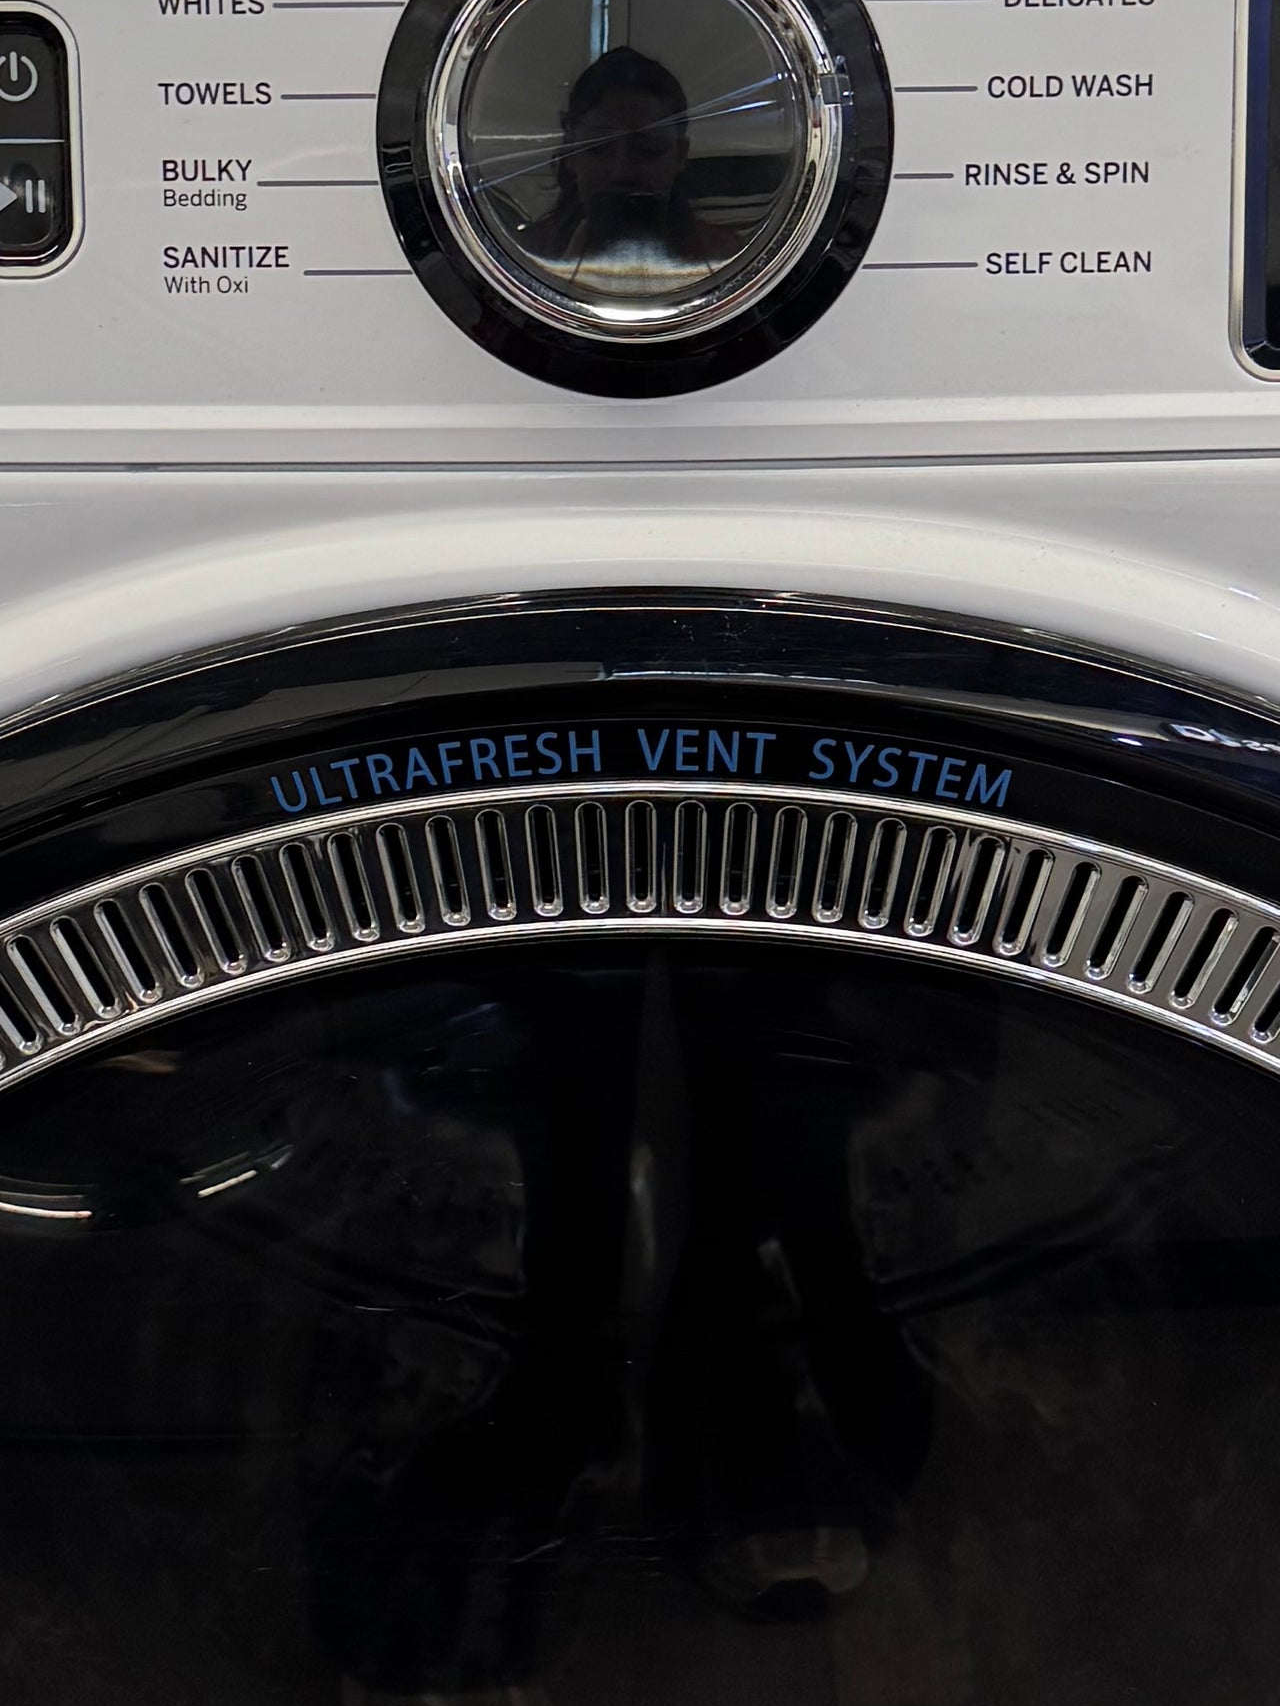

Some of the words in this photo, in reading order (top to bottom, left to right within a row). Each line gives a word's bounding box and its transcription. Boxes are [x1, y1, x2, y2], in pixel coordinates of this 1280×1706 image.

[158, 83, 271, 105] TOWELS
[988, 76, 1063, 98] COLD
[1072, 74, 1152, 97] WASH
[163, 160, 251, 181] BULKY
[966, 163, 1048, 185] RINSE
[1057, 163, 1076, 184] &
[1085, 162, 1148, 184] SPIN
[164, 189, 247, 211] Bedding
[164, 246, 289, 268] SANITIZE
[987, 253, 1052, 274] SELF
[1061, 251, 1151, 273] CLEAN
[165, 277, 210, 293] With
[217, 276, 248, 293] Oxi
[270, 730, 604, 814] ULTRAFRESH
[637, 728, 777, 774] VENT
[809, 738, 1015, 810] SYSTEM
